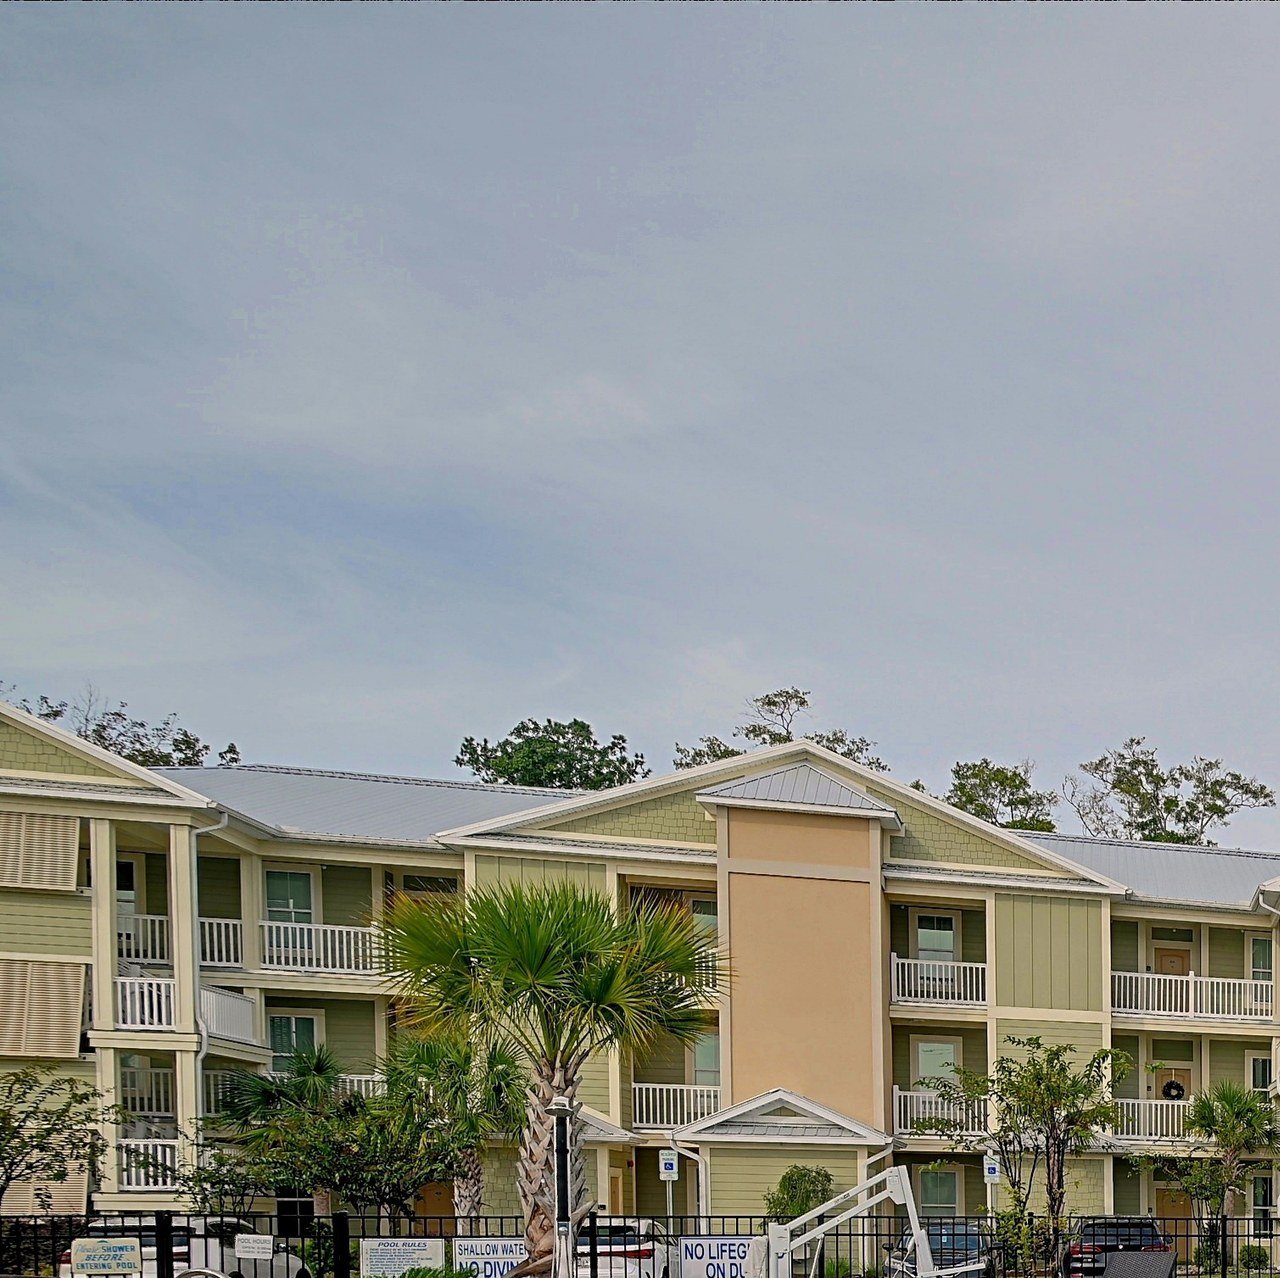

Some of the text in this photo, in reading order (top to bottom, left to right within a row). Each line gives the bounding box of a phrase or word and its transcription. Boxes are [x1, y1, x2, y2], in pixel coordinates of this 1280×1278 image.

[101, 1245, 136, 1253] SHOWER
[458, 1243, 527, 1256] SHALLOW WATE
[685, 1243, 704, 1260] NO
[85, 1253, 125, 1261] BEFORE
[76, 1262, 112, 1270] ENTERING
[706, 1263, 746, 1278] ON DU
